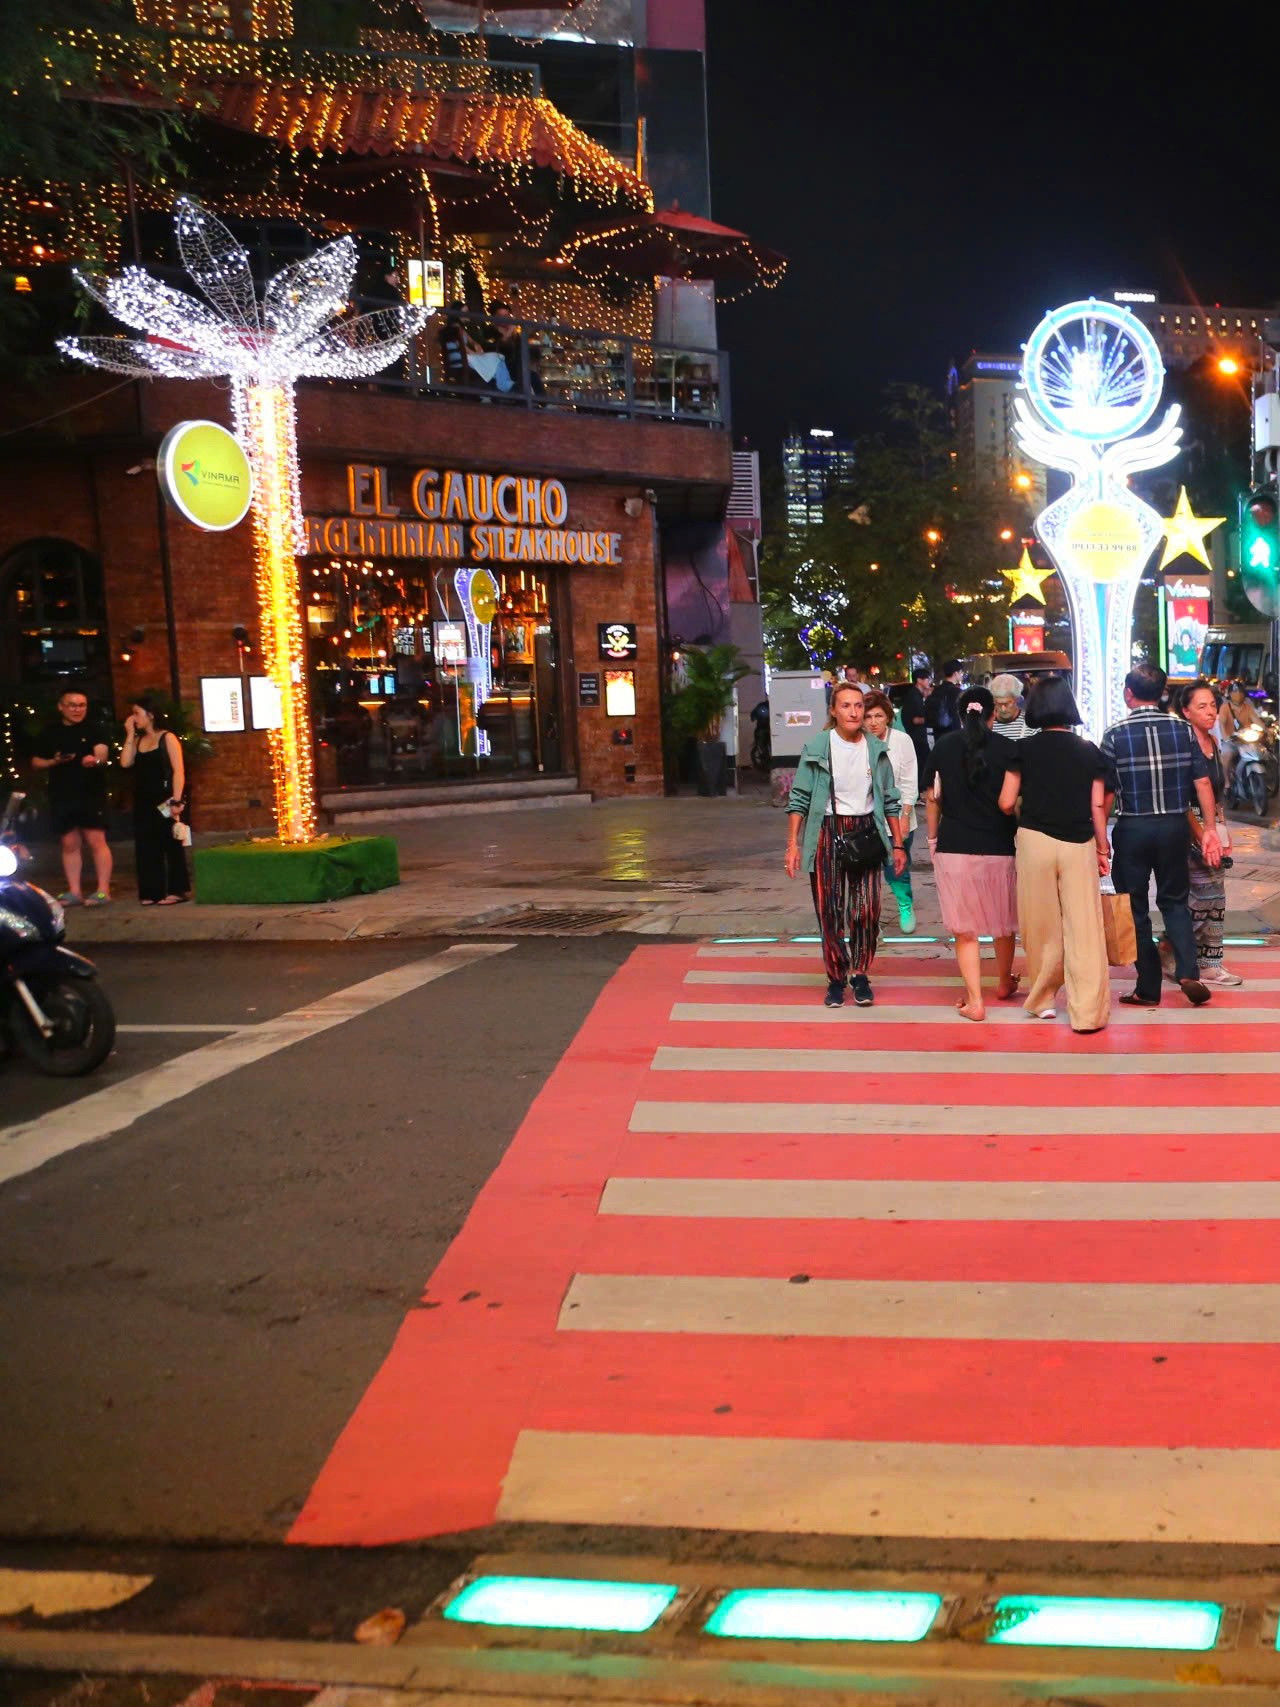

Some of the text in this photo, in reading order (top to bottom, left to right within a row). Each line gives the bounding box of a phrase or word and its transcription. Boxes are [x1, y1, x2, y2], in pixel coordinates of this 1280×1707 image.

[348, 464, 568, 527] EL GAUCHO
[302, 516, 622, 566] RGENTINIAN STEAKHOUSE
